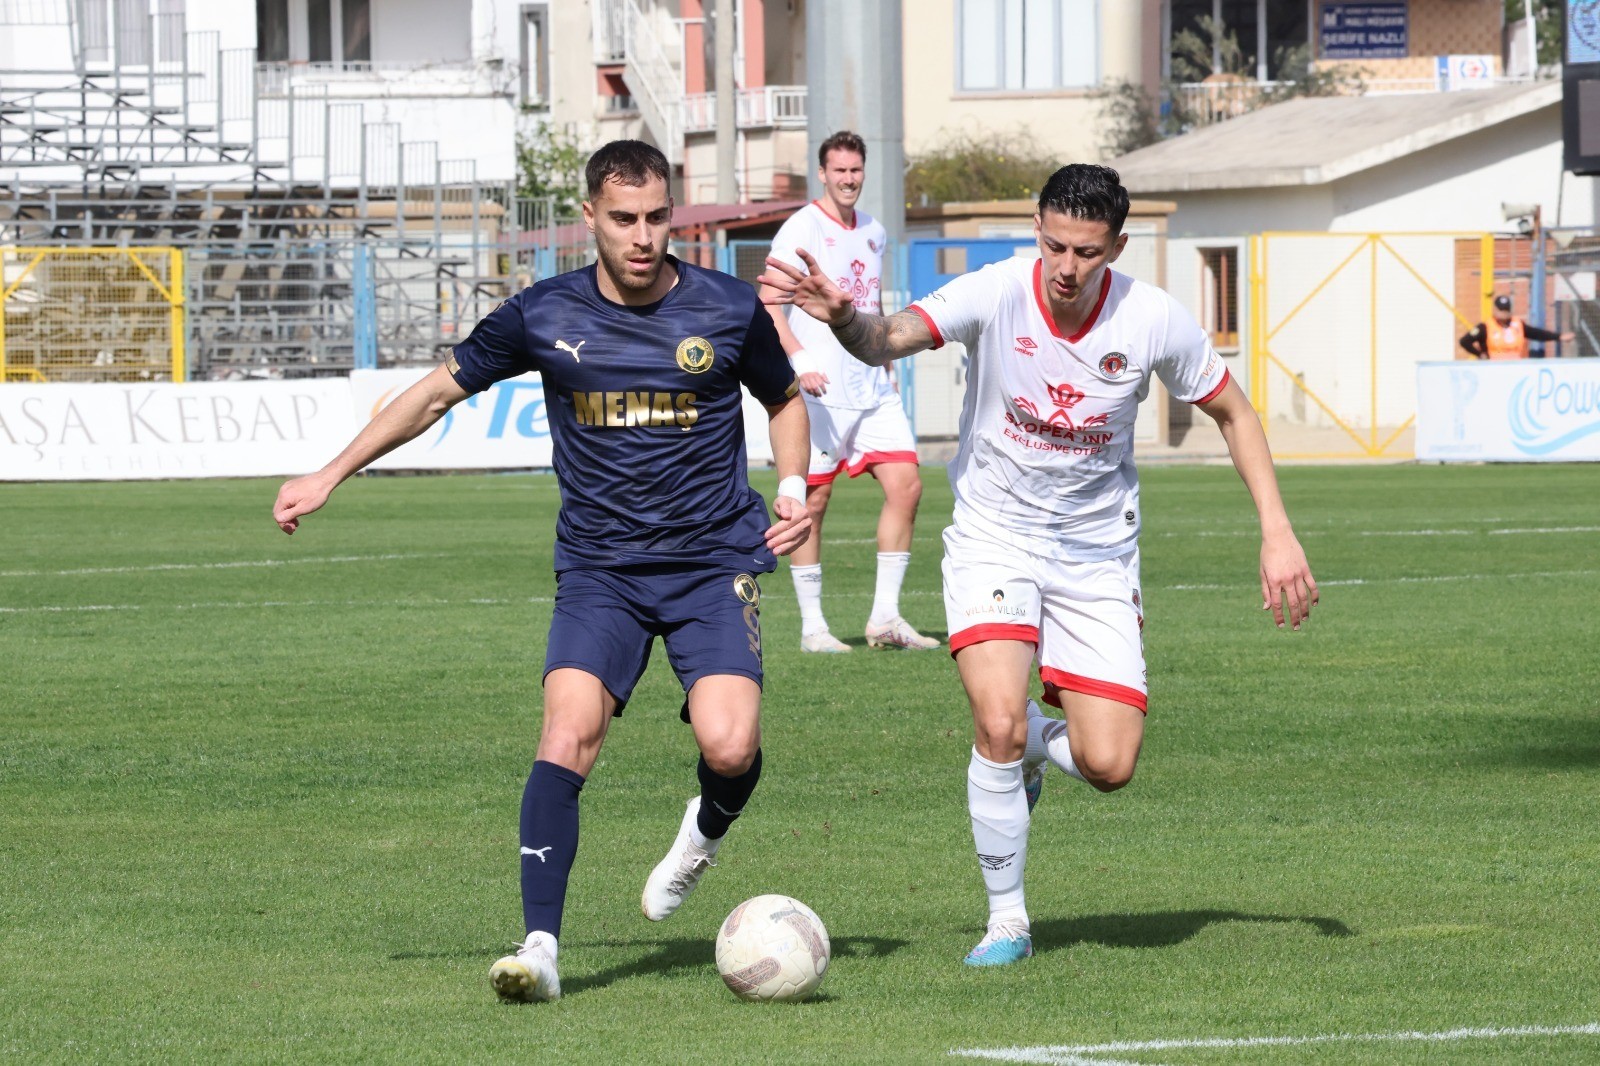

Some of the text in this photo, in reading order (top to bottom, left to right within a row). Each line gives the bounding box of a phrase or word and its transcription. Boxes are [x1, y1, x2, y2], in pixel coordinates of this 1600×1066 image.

[1014, 346, 1034, 357] umbro
[573, 391, 698, 431] MENAŞ
[1537, 368, 1600, 415] Pow
[122, 388, 318, 445] KEBAP
[1003, 428, 1102, 456] EXCLUSIVE OTEL
